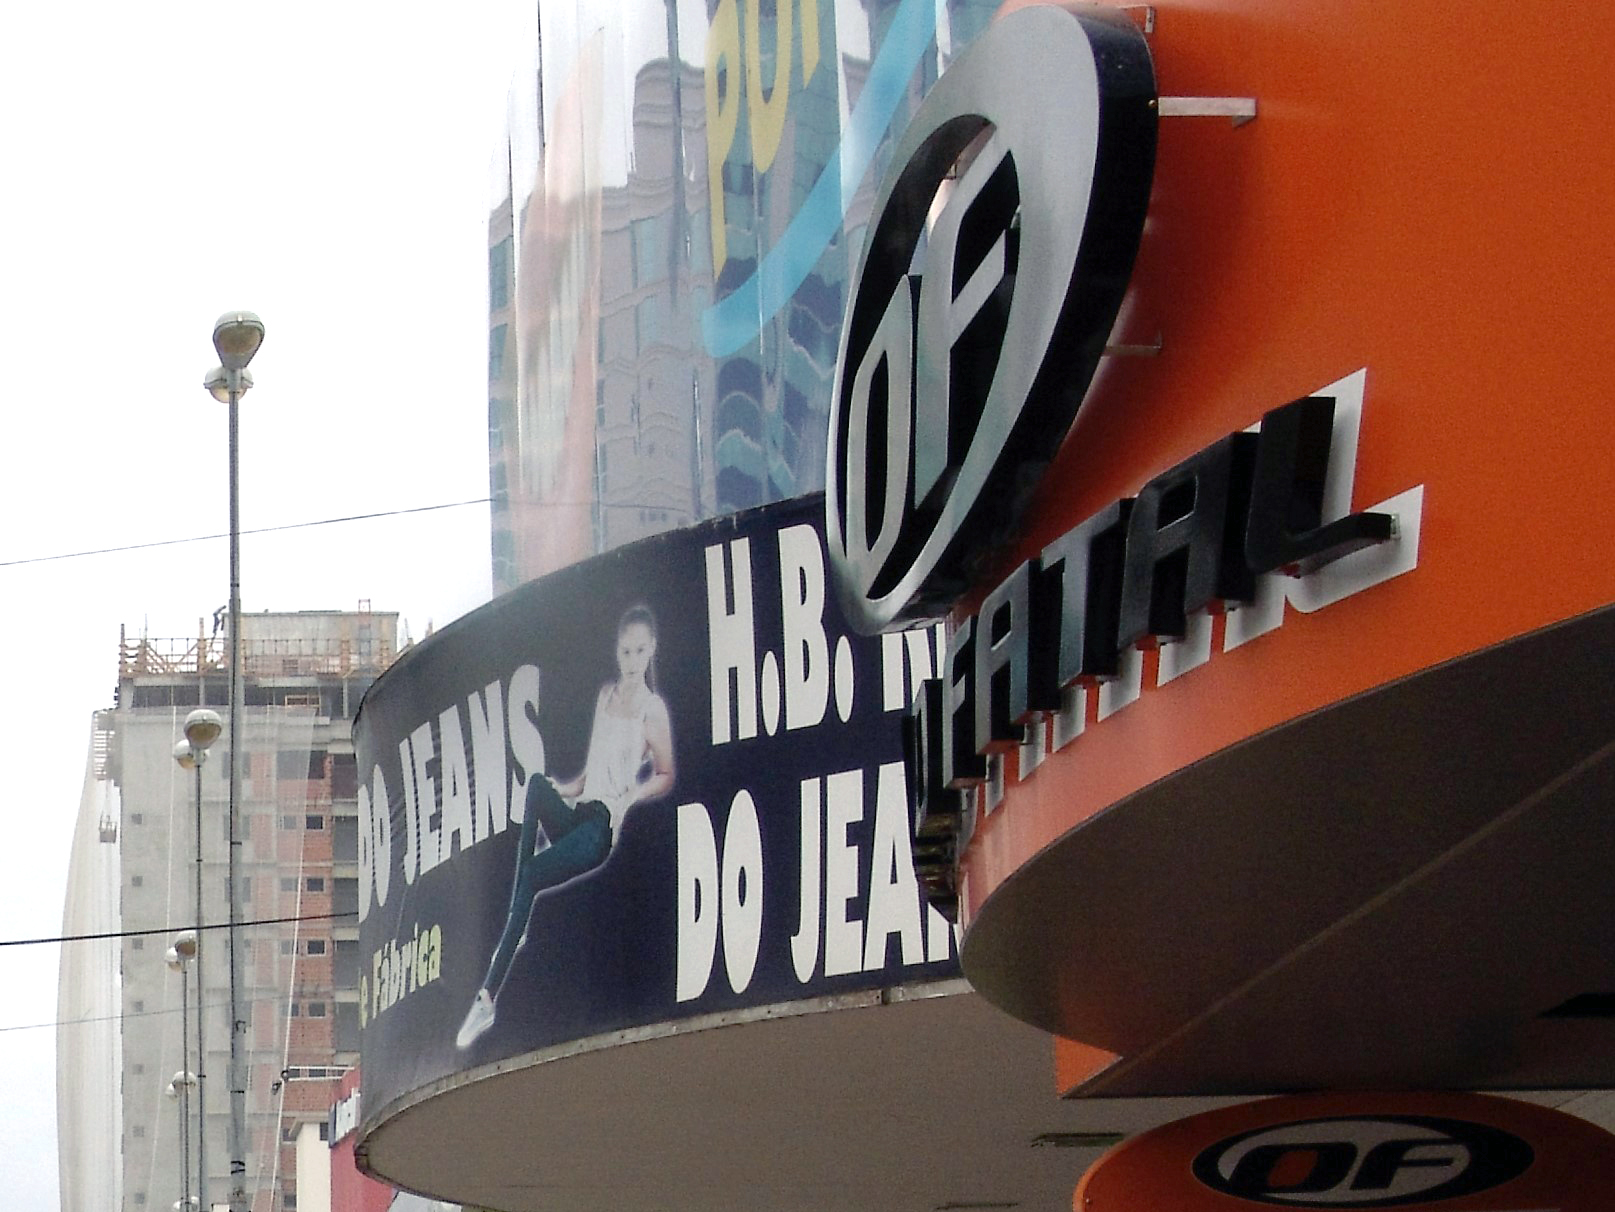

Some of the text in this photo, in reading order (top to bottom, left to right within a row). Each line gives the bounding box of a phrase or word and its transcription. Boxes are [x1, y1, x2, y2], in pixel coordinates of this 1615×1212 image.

[942, 385, 1399, 790] FATAL
[399, 664, 546, 886] JEANS
[676, 788, 764, 1003] DO
